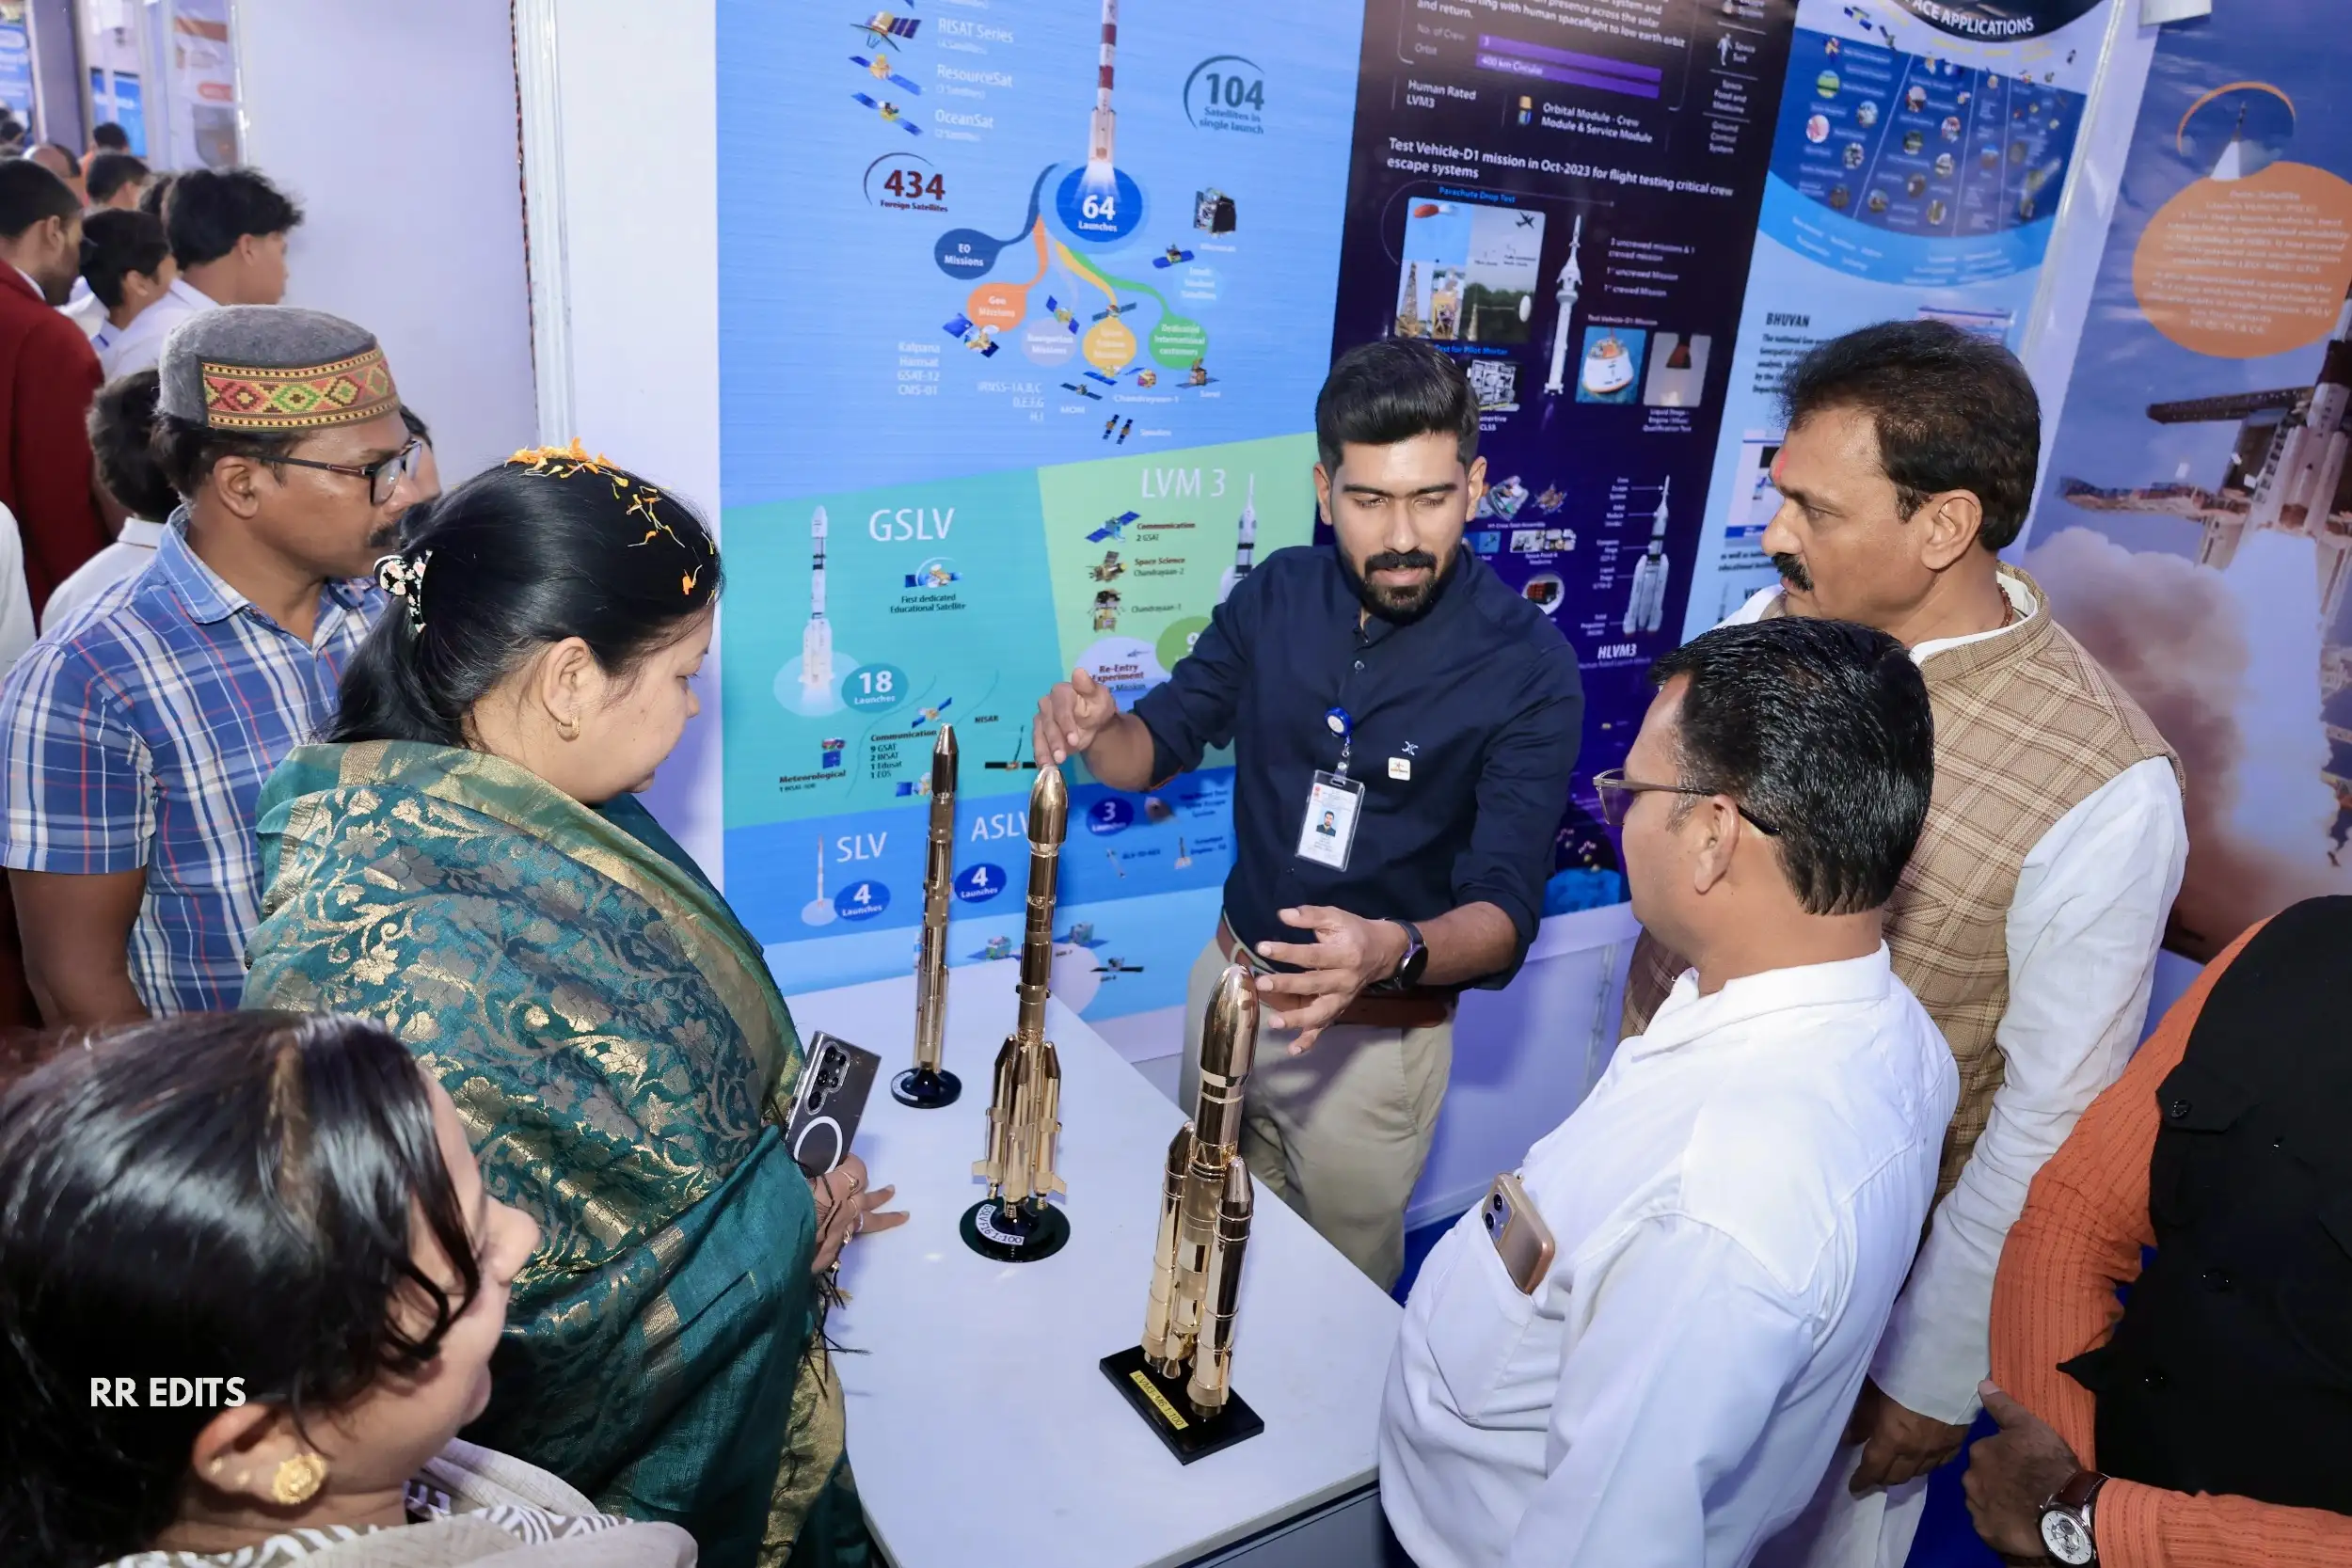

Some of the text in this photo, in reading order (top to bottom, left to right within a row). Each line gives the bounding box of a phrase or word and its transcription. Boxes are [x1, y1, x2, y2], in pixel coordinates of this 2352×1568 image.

[1417, 0, 1438, 10] and
[1645, 4, 1662, 15] and
[1500, 2, 1686, 47] with human spaceflight to low earth orbit
[1591, 8, 1620, 20] across
[1621, 12, 1636, 24] the
[1638, 17, 1660, 28] solar
[1941, 10, 2035, 36] APPLICATIONS
[938, 18, 1014, 43] RISAT Series
[1415, 43, 1438, 55] Orbit
[937, 64, 1013, 88] ResourceSat
[1205, 72, 1264, 111] 104
[1408, 79, 1476, 101] Human Rated
[1406, 94, 1435, 108] LVM3
[934, 108, 993, 129] OceanSat
[1204, 106, 1262, 123] Satellites in
[1543, 102, 1576, 117] Orbital
[1576, 108, 1611, 123] Module
[1617, 115, 1640, 127] Crew
[1199, 118, 1264, 135] single launch
[1542, 117, 1653, 143] Module & Service Module
[1387, 156, 1480, 179] escape systems
[1390, 137, 1734, 198] Test Vehicle-D1 mission in Oct-2023 for flight testing critical crew
[884, 169, 946, 200] 434
[1438, 186, 1478, 199] Parachute
[1479, 191, 1499, 203] Drop
[880, 199, 948, 213] Foreign Satellites
[1083, 194, 1116, 221] 64
[1078, 220, 1118, 232] Launches
[958, 243, 971, 254] EO
[944, 255, 984, 267] Missions
[1766, 312, 1810, 327] BHUVAN
[898, 370, 940, 382] GSAT-12
[1141, 467, 1226, 499] LVM 3
[868, 507, 956, 542] GSLV
[1136, 521, 1196, 531] Communication
[1135, 556, 1185, 566] Space Science
[900, 594, 956, 604] First dedicated
[890, 602, 967, 614] Educational Satellite
[1597, 643, 1637, 659] HLVM3
[1099, 664, 1138, 674] Re-Entry
[859, 671, 893, 694] 18
[1091, 672, 1144, 684] Experiment
[854, 696, 896, 705] Launches
[870, 729, 937, 742] Communication
[878, 743, 897, 753] GSAT
[870, 752, 899, 763] 2 INSAT
[877, 761, 902, 771] Edusat
[779, 769, 846, 784] Meteorological
[1103, 801, 1116, 821] 3
[836, 832, 887, 863] SLV
[972, 866, 988, 887] 4
[853, 883, 871, 904] 4
[961, 887, 998, 898] Launches
[842, 904, 882, 917] Launches
[977, 1205, 1023, 1243] GSLV F16 1:100
